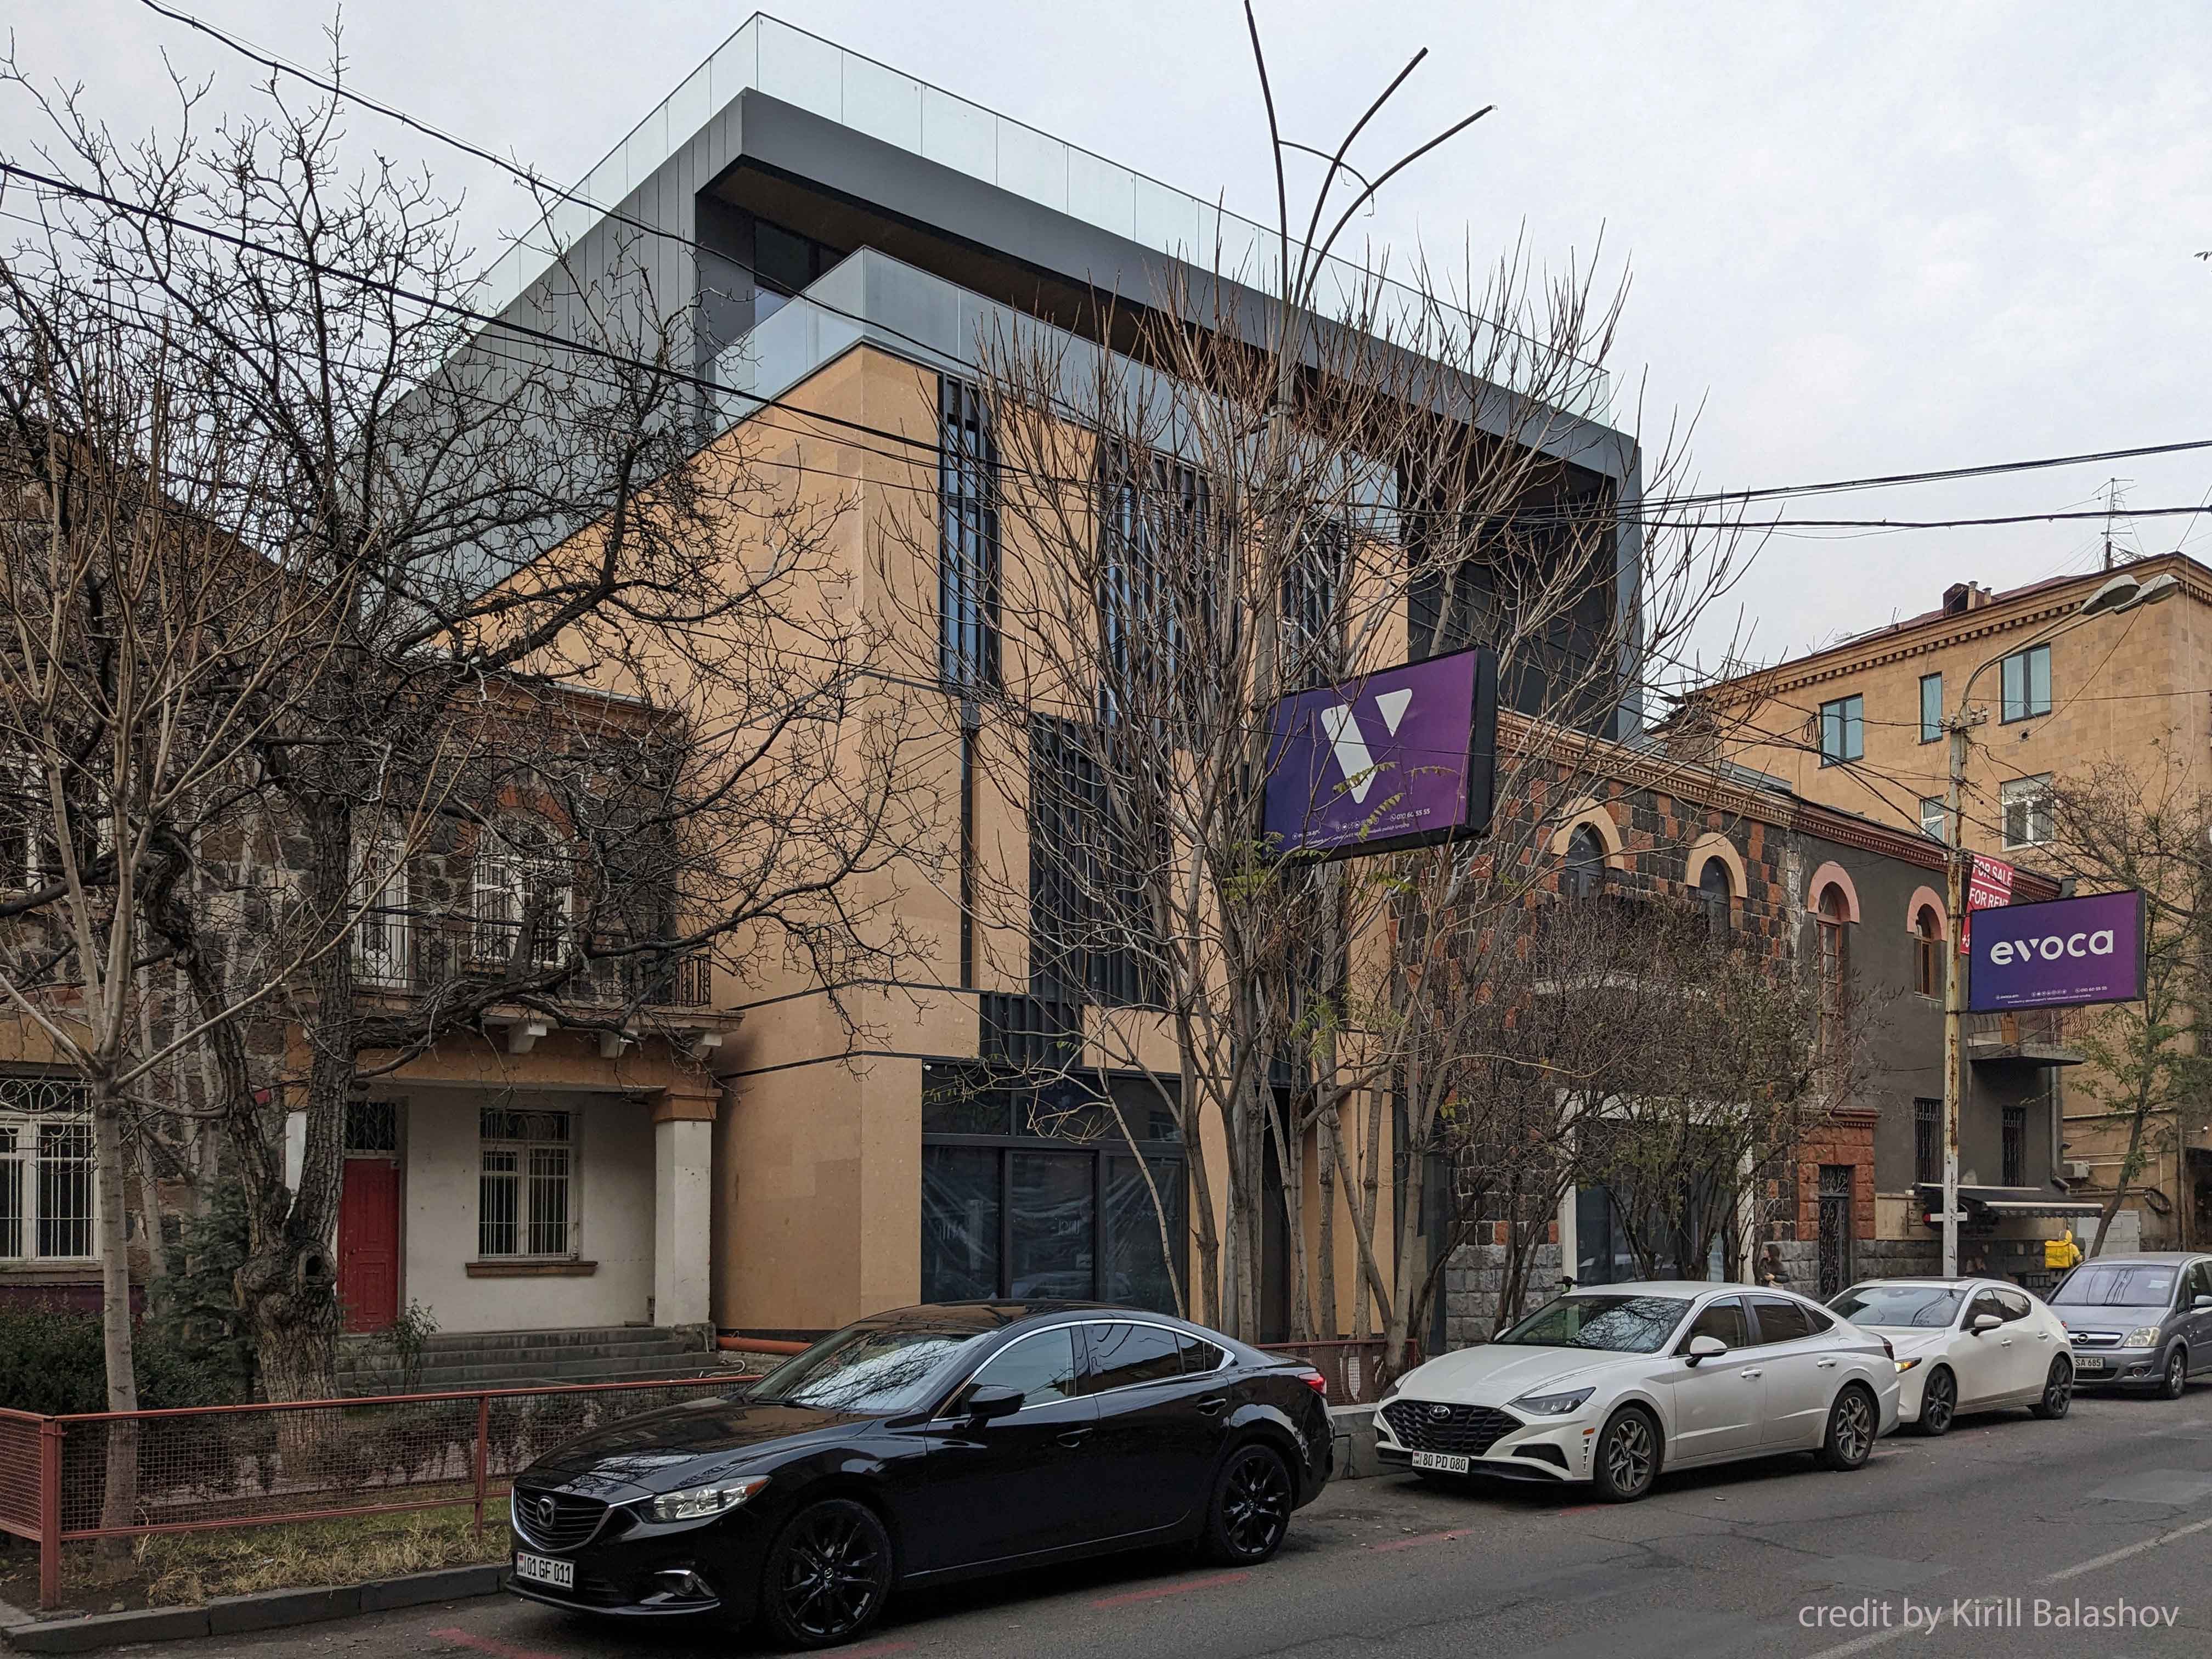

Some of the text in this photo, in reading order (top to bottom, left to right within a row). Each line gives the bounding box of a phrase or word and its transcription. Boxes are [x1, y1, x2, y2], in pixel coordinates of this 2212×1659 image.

[1973, 859, 2012, 887] FOR SALE
[1969, 887, 1987, 906] FOR
[1990, 930, 2113, 965] evoca
[1423, 1454, 1433, 1466] 80
[1435, 1455, 1448, 1468] PD
[1450, 1457, 1466, 1470] 080
[527, 1557, 537, 1576] 01
[539, 1560, 551, 1579] GF
[554, 1563, 571, 1584] 011
